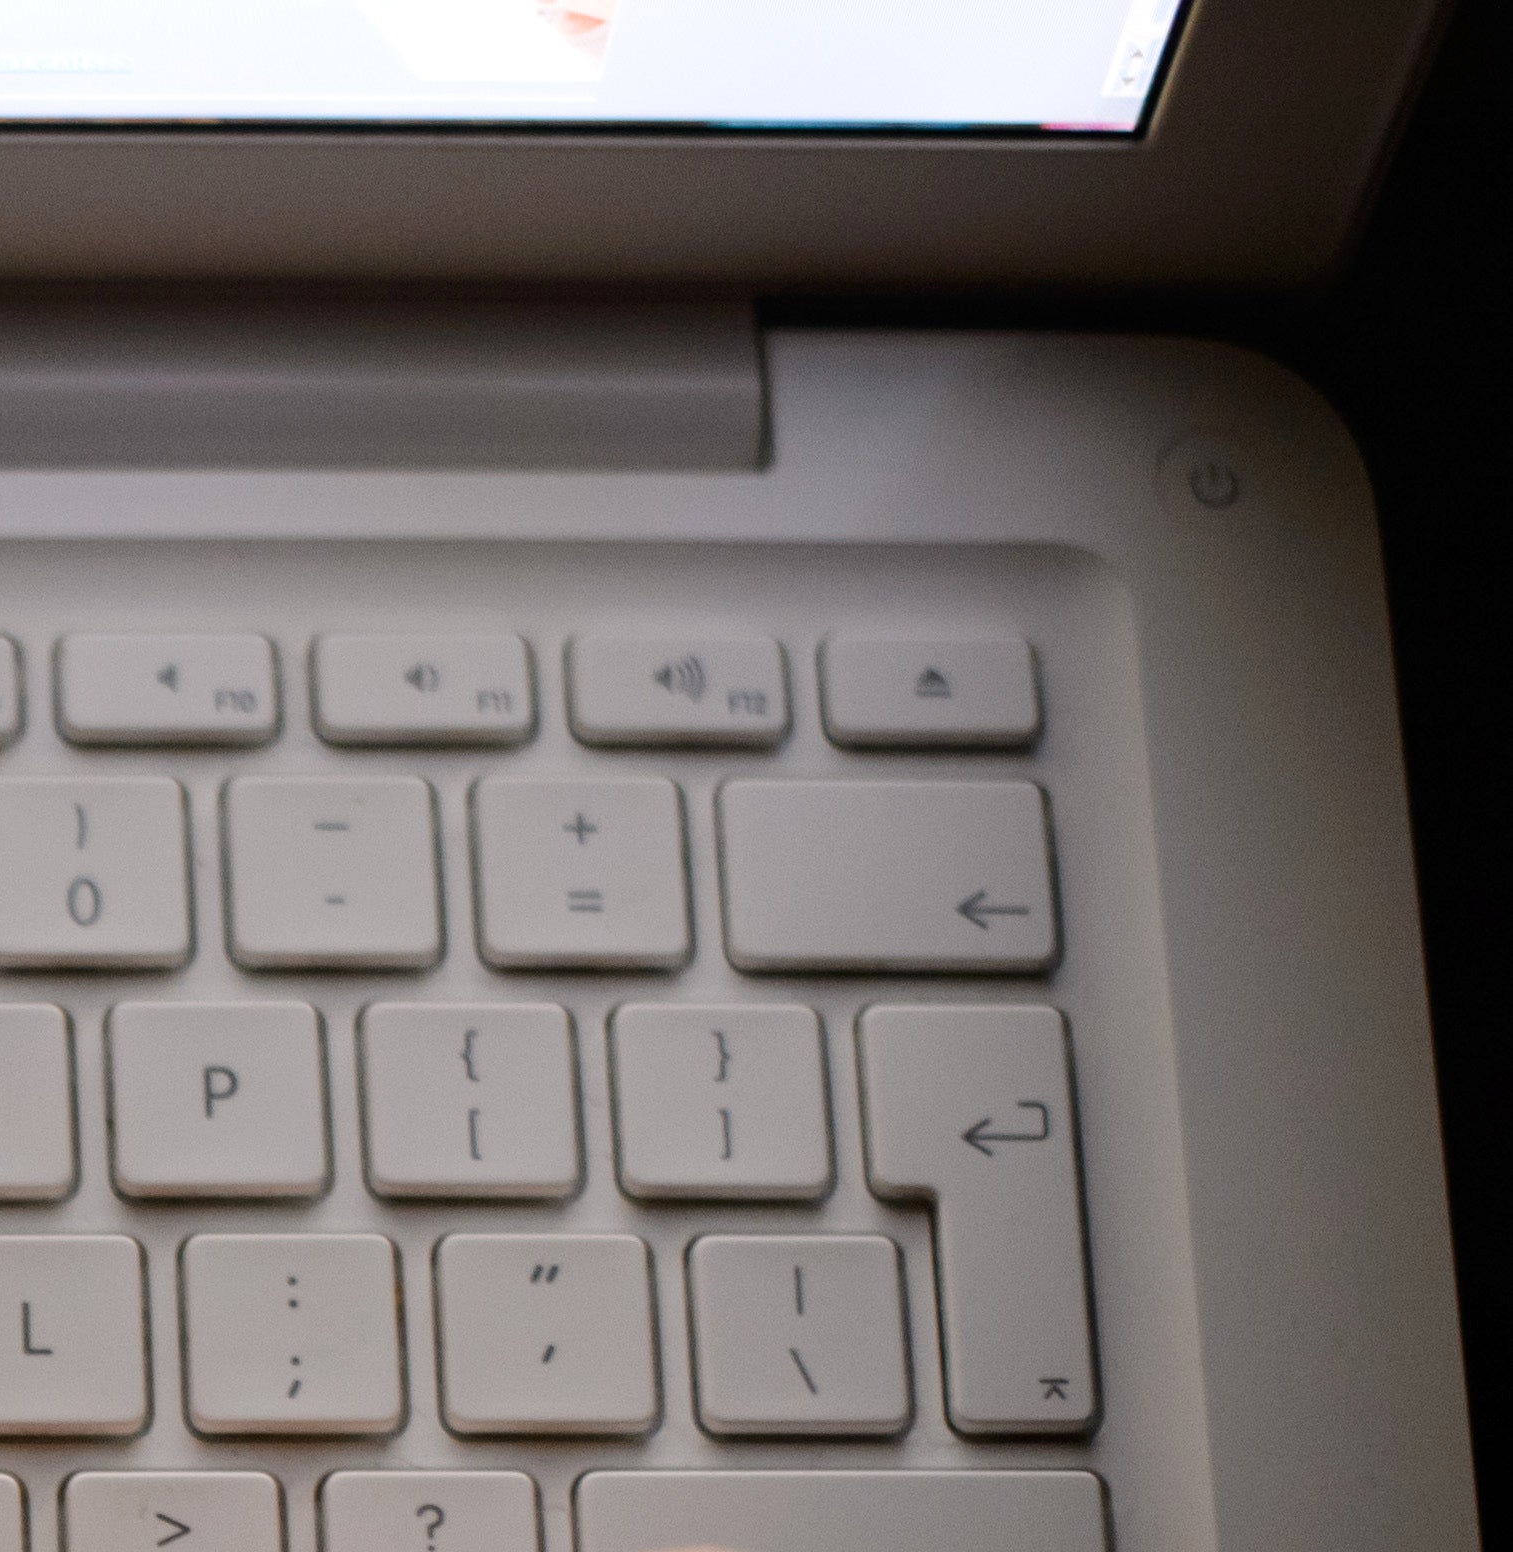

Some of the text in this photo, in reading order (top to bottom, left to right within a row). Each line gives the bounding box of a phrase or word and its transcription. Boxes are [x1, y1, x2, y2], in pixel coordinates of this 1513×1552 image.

[214, 689, 258, 713] F10
[476, 690, 513, 713] F11
[727, 691, 769, 716] F12
[73, 802, 90, 850] )
[564, 812, 598, 844] +
[66, 875, 104, 927] 0
[567, 889, 604, 914] =
[460, 1028, 479, 1082] {
[712, 1029, 732, 1083] }
[202, 1065, 240, 1119] P
[466, 1106, 483, 1162] [
[717, 1106, 734, 1162] ]
[21, 1301, 53, 1357] L
[286, 1354, 303, 1399] ;
[788, 1347, 818, 1395] \
[156, 1512, 192, 1547] >
[415, 1502, 446, 1552] ?
